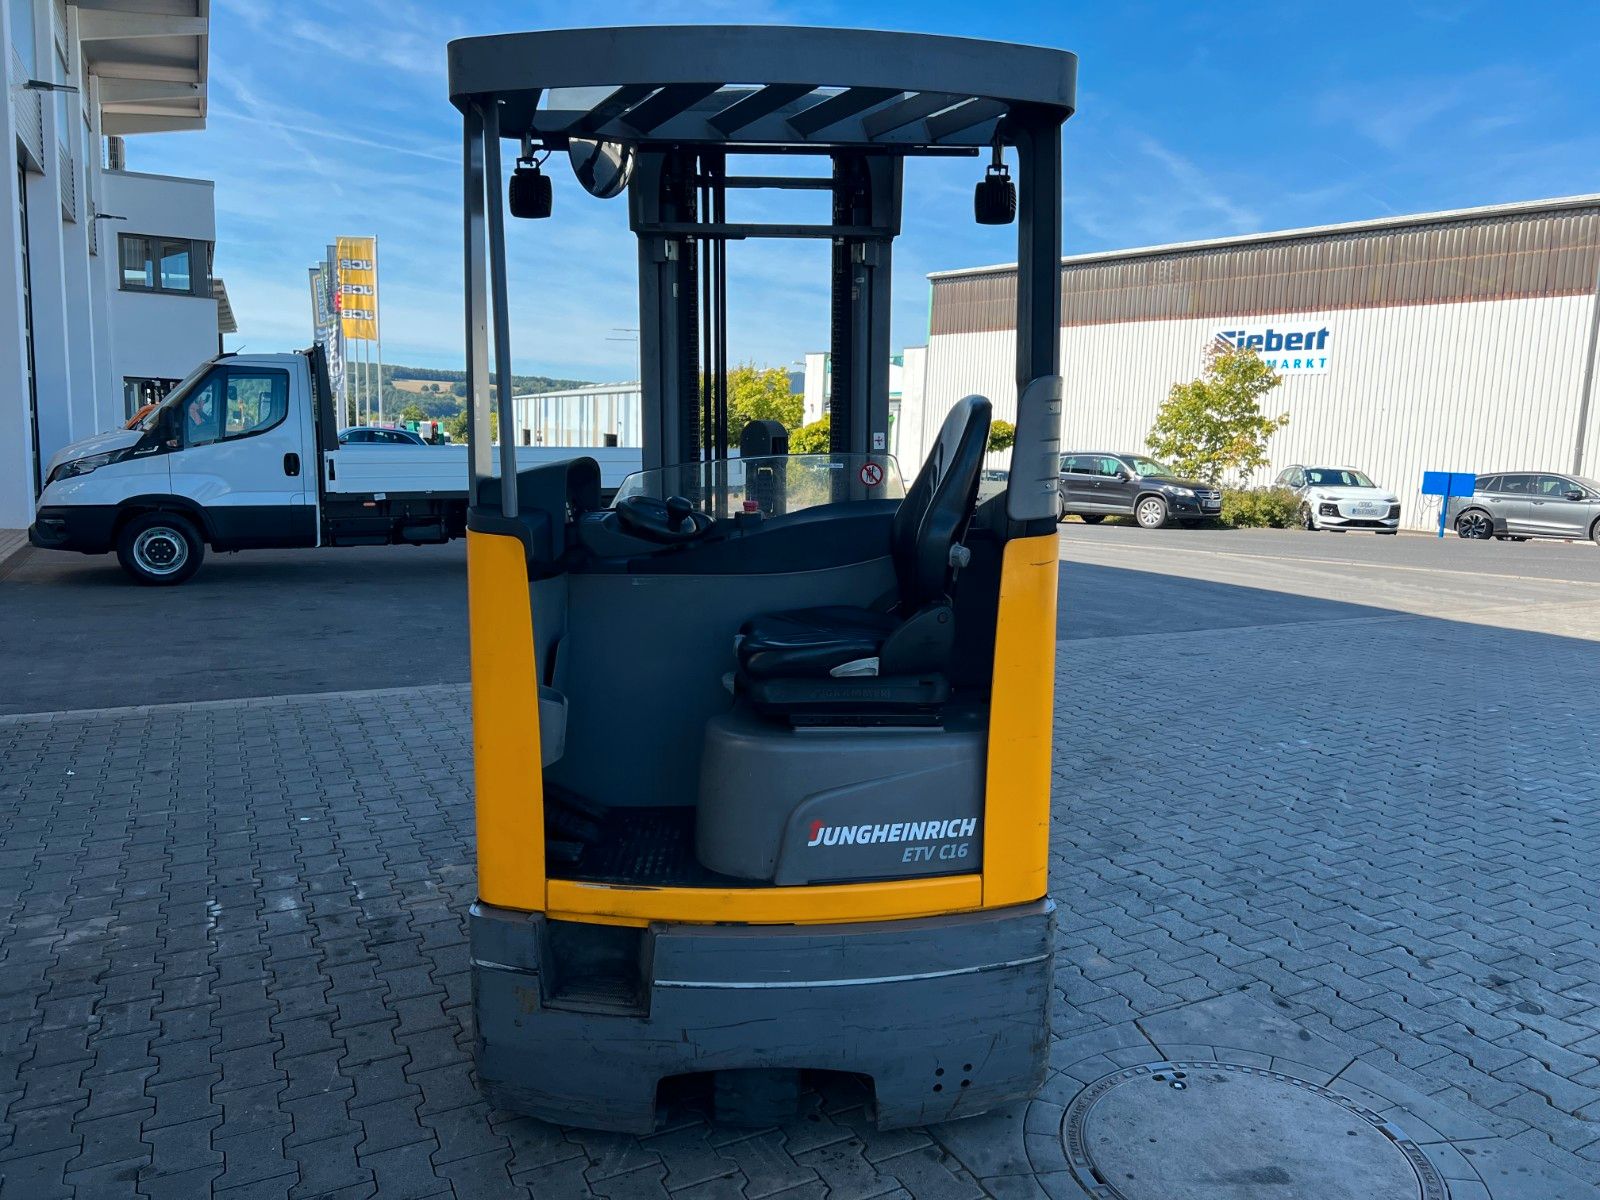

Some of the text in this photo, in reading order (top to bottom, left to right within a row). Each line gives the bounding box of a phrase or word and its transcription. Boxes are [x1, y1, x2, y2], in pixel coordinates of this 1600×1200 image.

[808, 818, 977, 847] JUNGHEINRICH
[902, 843, 969, 863] ETV C16
